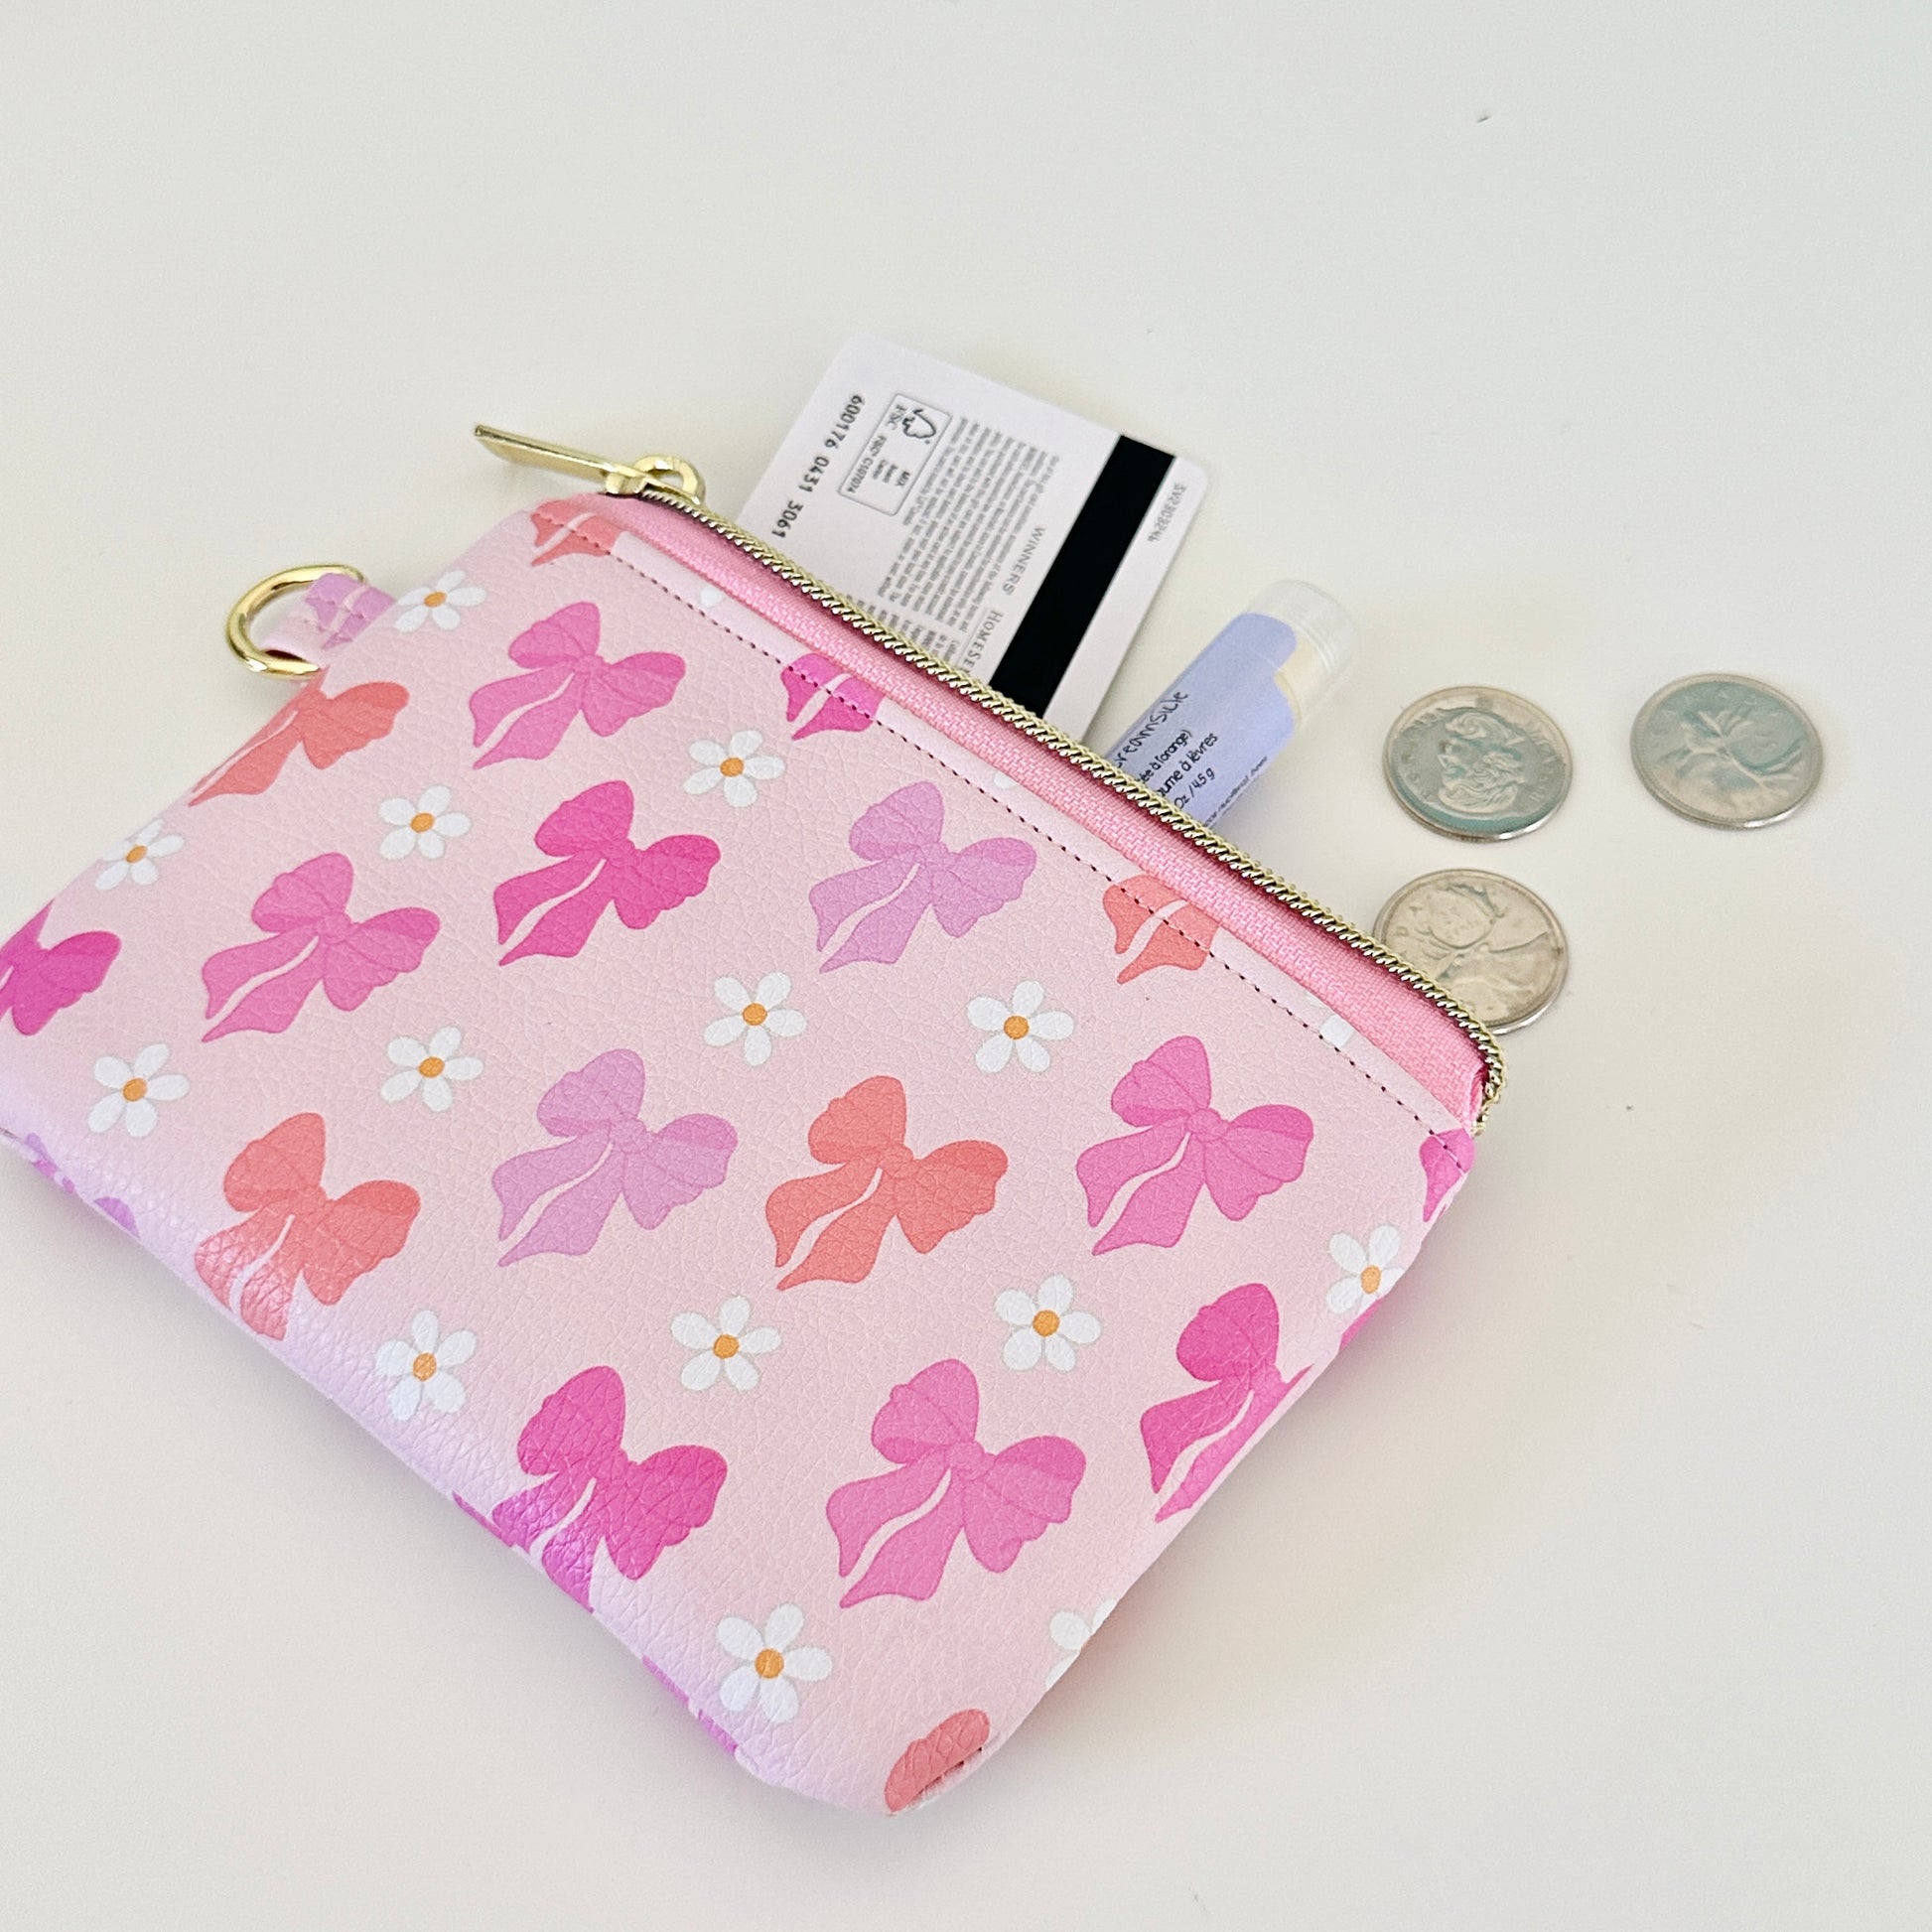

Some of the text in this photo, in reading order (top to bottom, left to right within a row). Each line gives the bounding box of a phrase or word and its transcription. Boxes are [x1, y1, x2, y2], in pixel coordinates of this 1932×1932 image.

[885, 403, 906, 431] FSC
[770, 394, 865, 538] 600176 0431 3061
[1002, 526, 1046, 596] WINNERS
[1111, 691, 1189, 768] reamsicle
[1177, 759, 1192, 772] à
[1185, 733, 1219, 764] lèvres
[1137, 768, 1155, 784] ée
[1204, 766, 1217, 781] g
